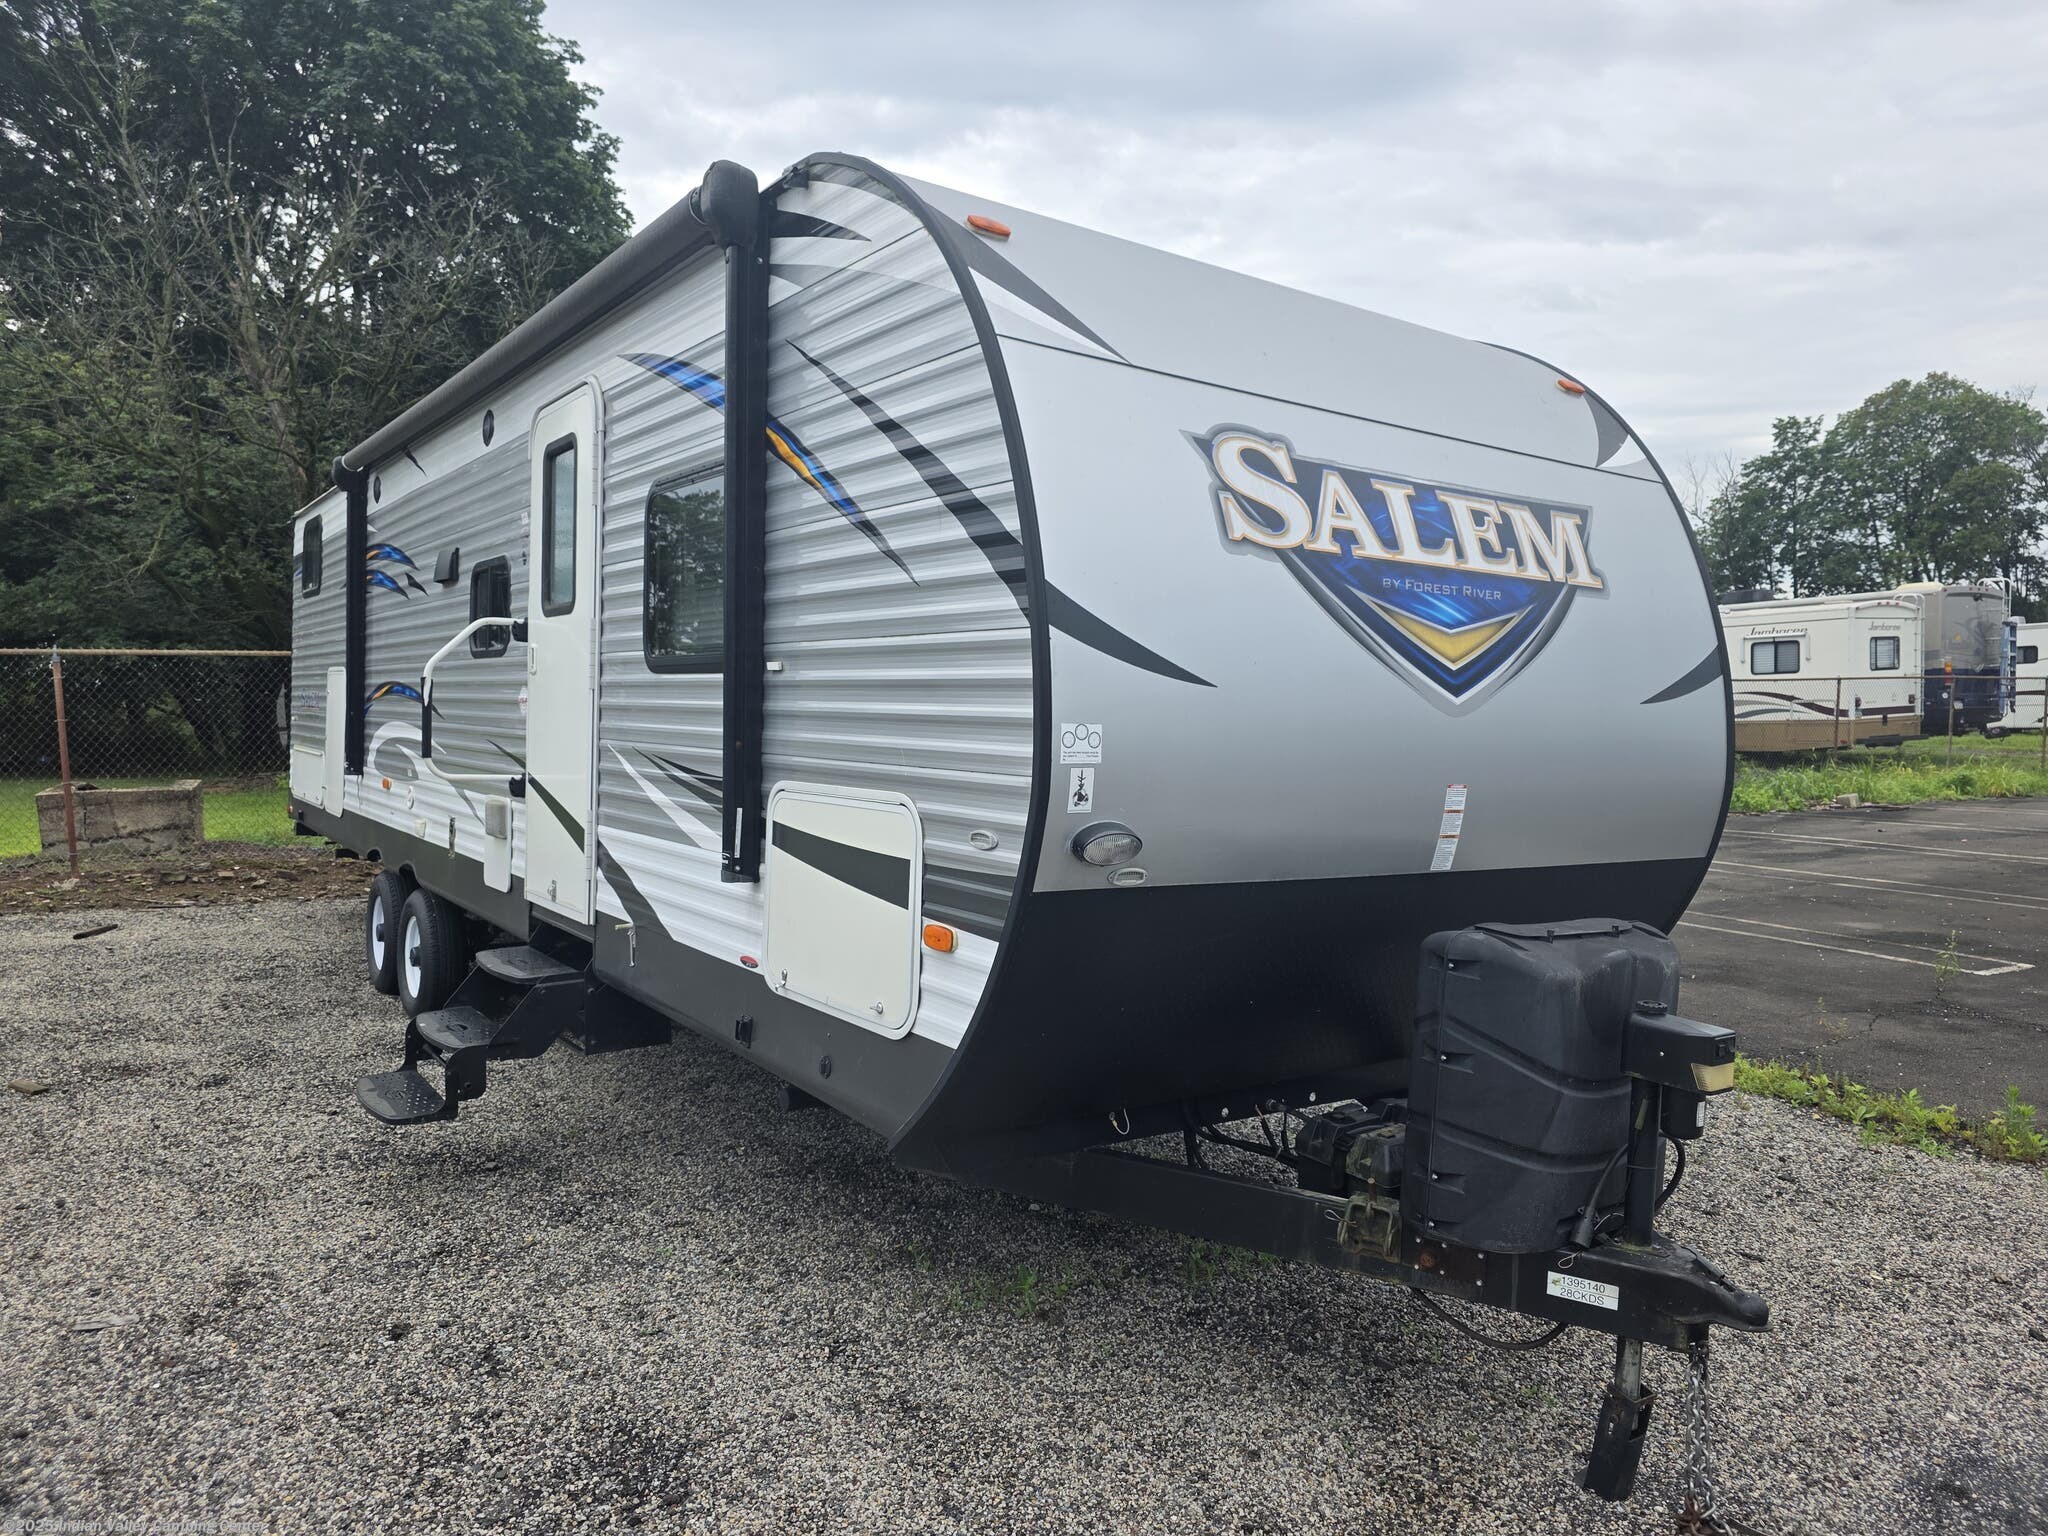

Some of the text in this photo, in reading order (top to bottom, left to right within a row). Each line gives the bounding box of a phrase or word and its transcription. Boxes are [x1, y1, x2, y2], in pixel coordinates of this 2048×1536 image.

[1212, 434, 1604, 589] SALEM
[1383, 578, 1502, 600] BY FOREST RIVER
[1561, 1276, 1605, 1294] 1395140
[1560, 1287, 1605, 1306] 28CKDS
